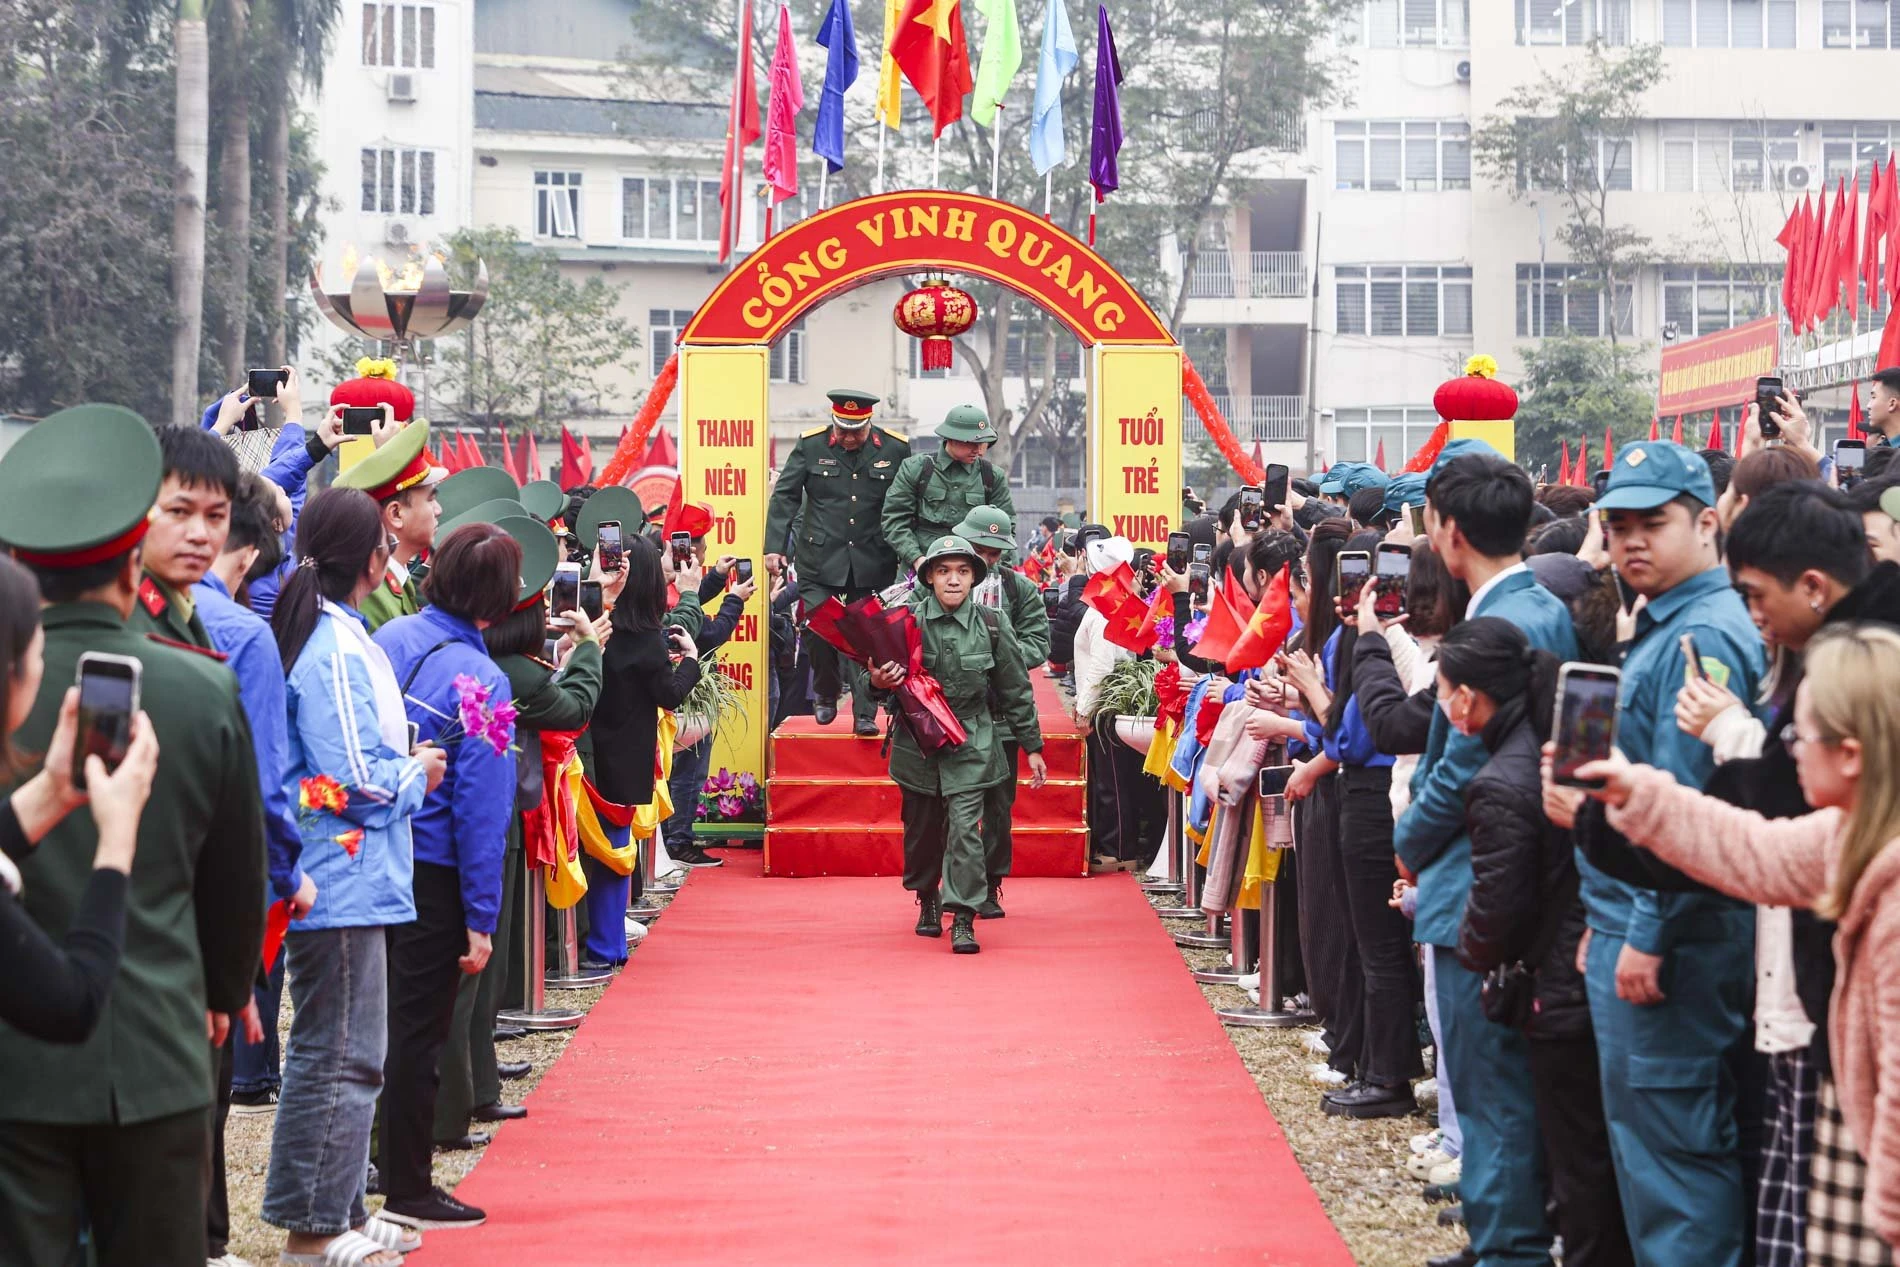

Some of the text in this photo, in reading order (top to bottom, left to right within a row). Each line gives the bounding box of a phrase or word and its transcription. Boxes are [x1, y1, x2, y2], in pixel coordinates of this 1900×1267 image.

[742, 205, 1126, 332] CỔNG VINH QUANG
[696, 419, 754, 447] THANH
[1118, 406, 1164, 446] TUỔI
[704, 462, 746, 496] NIÊN
[1122, 456, 1159, 494] TRẺ
[715, 511, 736, 545] TÔ
[1112, 514, 1169, 543] XUNG
